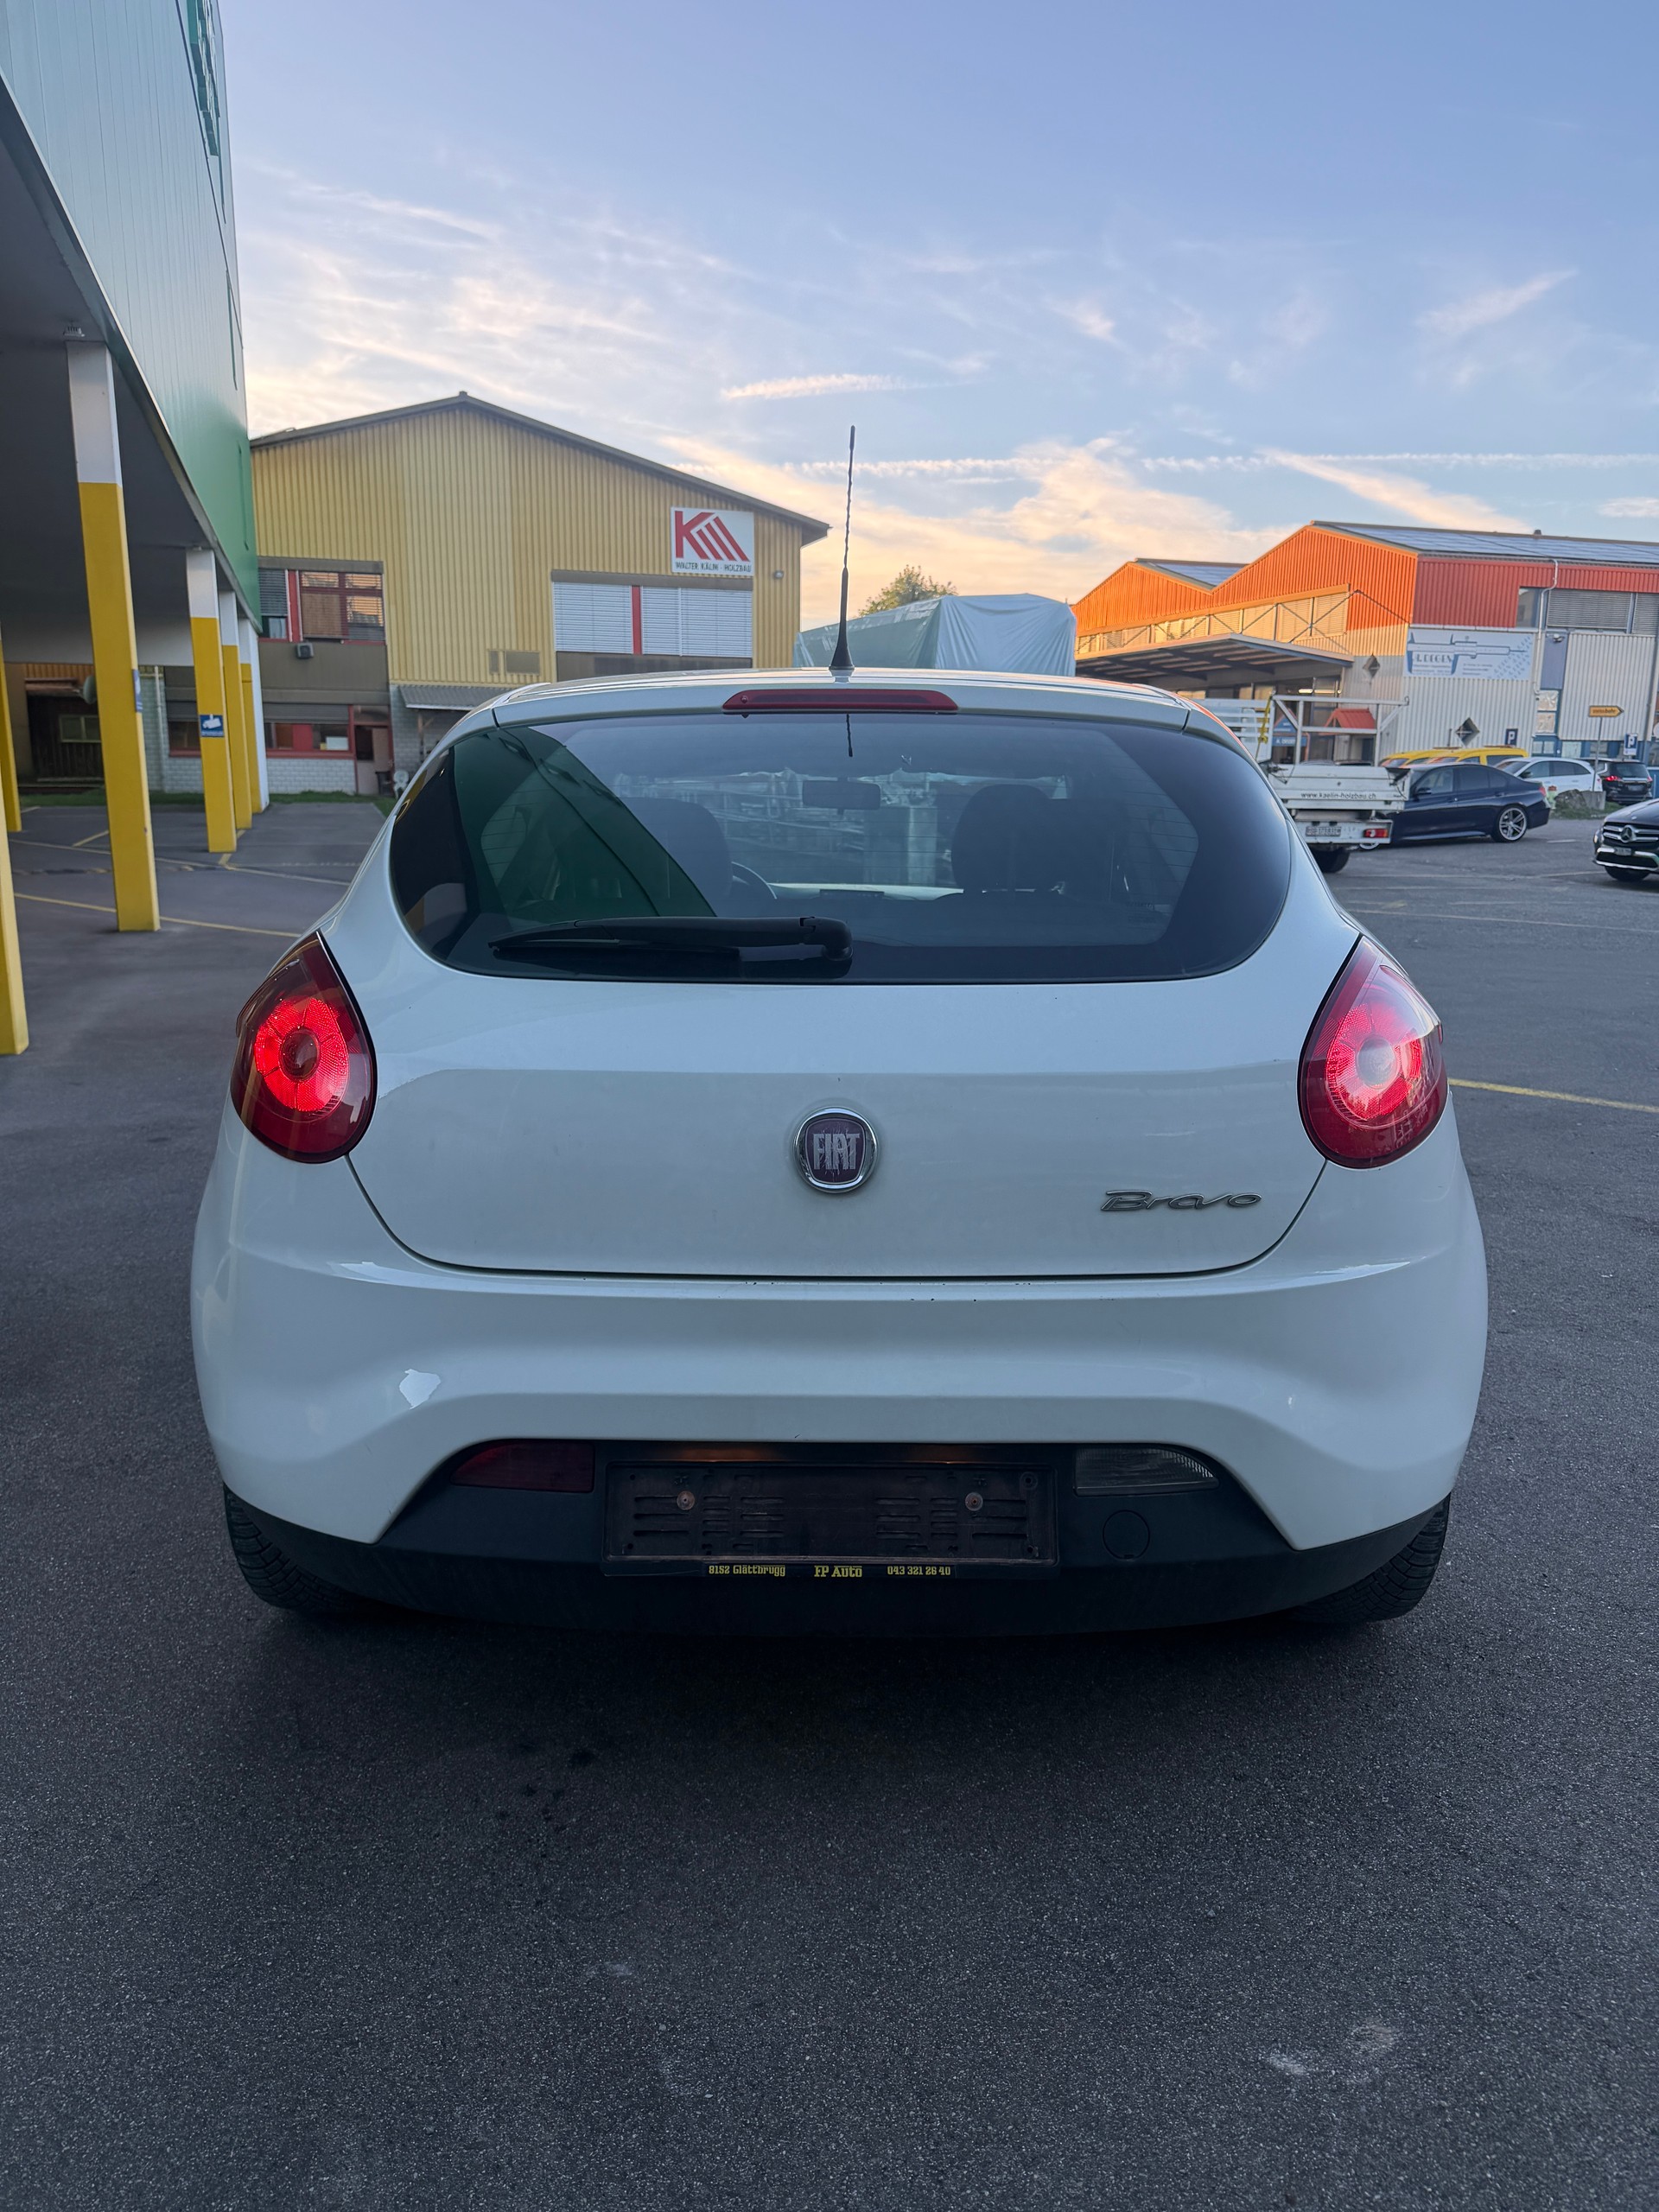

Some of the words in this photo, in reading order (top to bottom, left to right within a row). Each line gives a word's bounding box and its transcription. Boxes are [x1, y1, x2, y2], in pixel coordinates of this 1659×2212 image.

[676, 562, 698, 570] WALTER
[724, 563, 753, 573] HOLZBAU
[1423, 654, 1452, 663] DEGEN
[1508, 731, 1516, 744] P
[1628, 736, 1635, 747] P
[813, 1133, 860, 1170] FIAT
[1101, 1190, 1262, 1211] Bravo
[708, 1565, 730, 1574] 8152
[814, 1565, 830, 1577] FP
[831, 1565, 862, 1578] Auto
[887, 1566, 906, 1575] 043
[907, 1566, 924, 1575] 321
[925, 1566, 937, 1575] 26
[938, 1566, 951, 1575] 40
